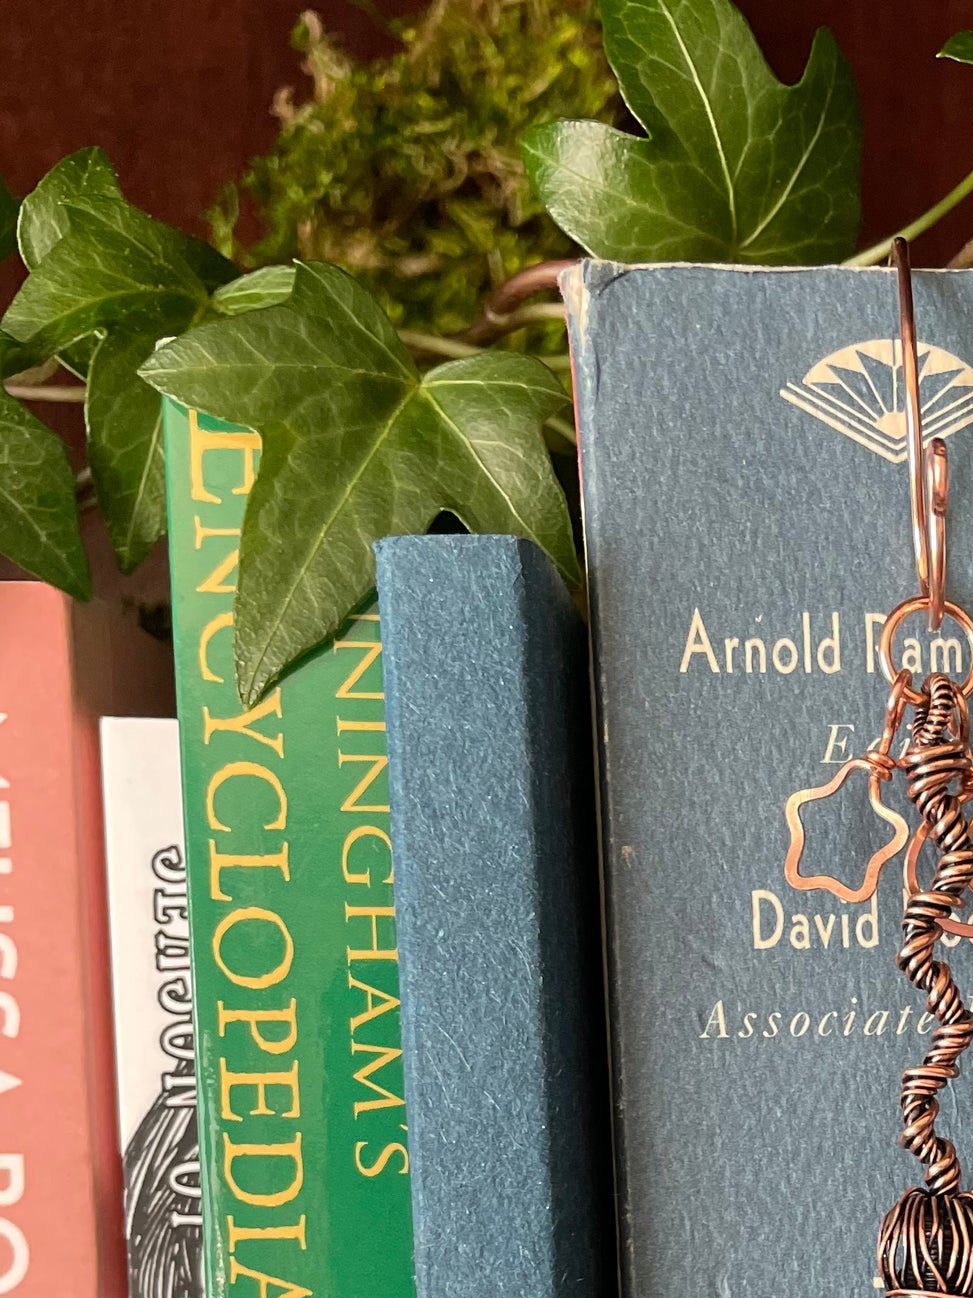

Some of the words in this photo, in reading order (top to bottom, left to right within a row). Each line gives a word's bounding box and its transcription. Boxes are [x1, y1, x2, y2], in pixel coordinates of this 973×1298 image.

[679, 606, 842, 675] Arnold
[334, 613, 410, 1177] NINGHAM'S
[751, 888, 880, 950] David
[698, 996, 934, 1040] Associate
